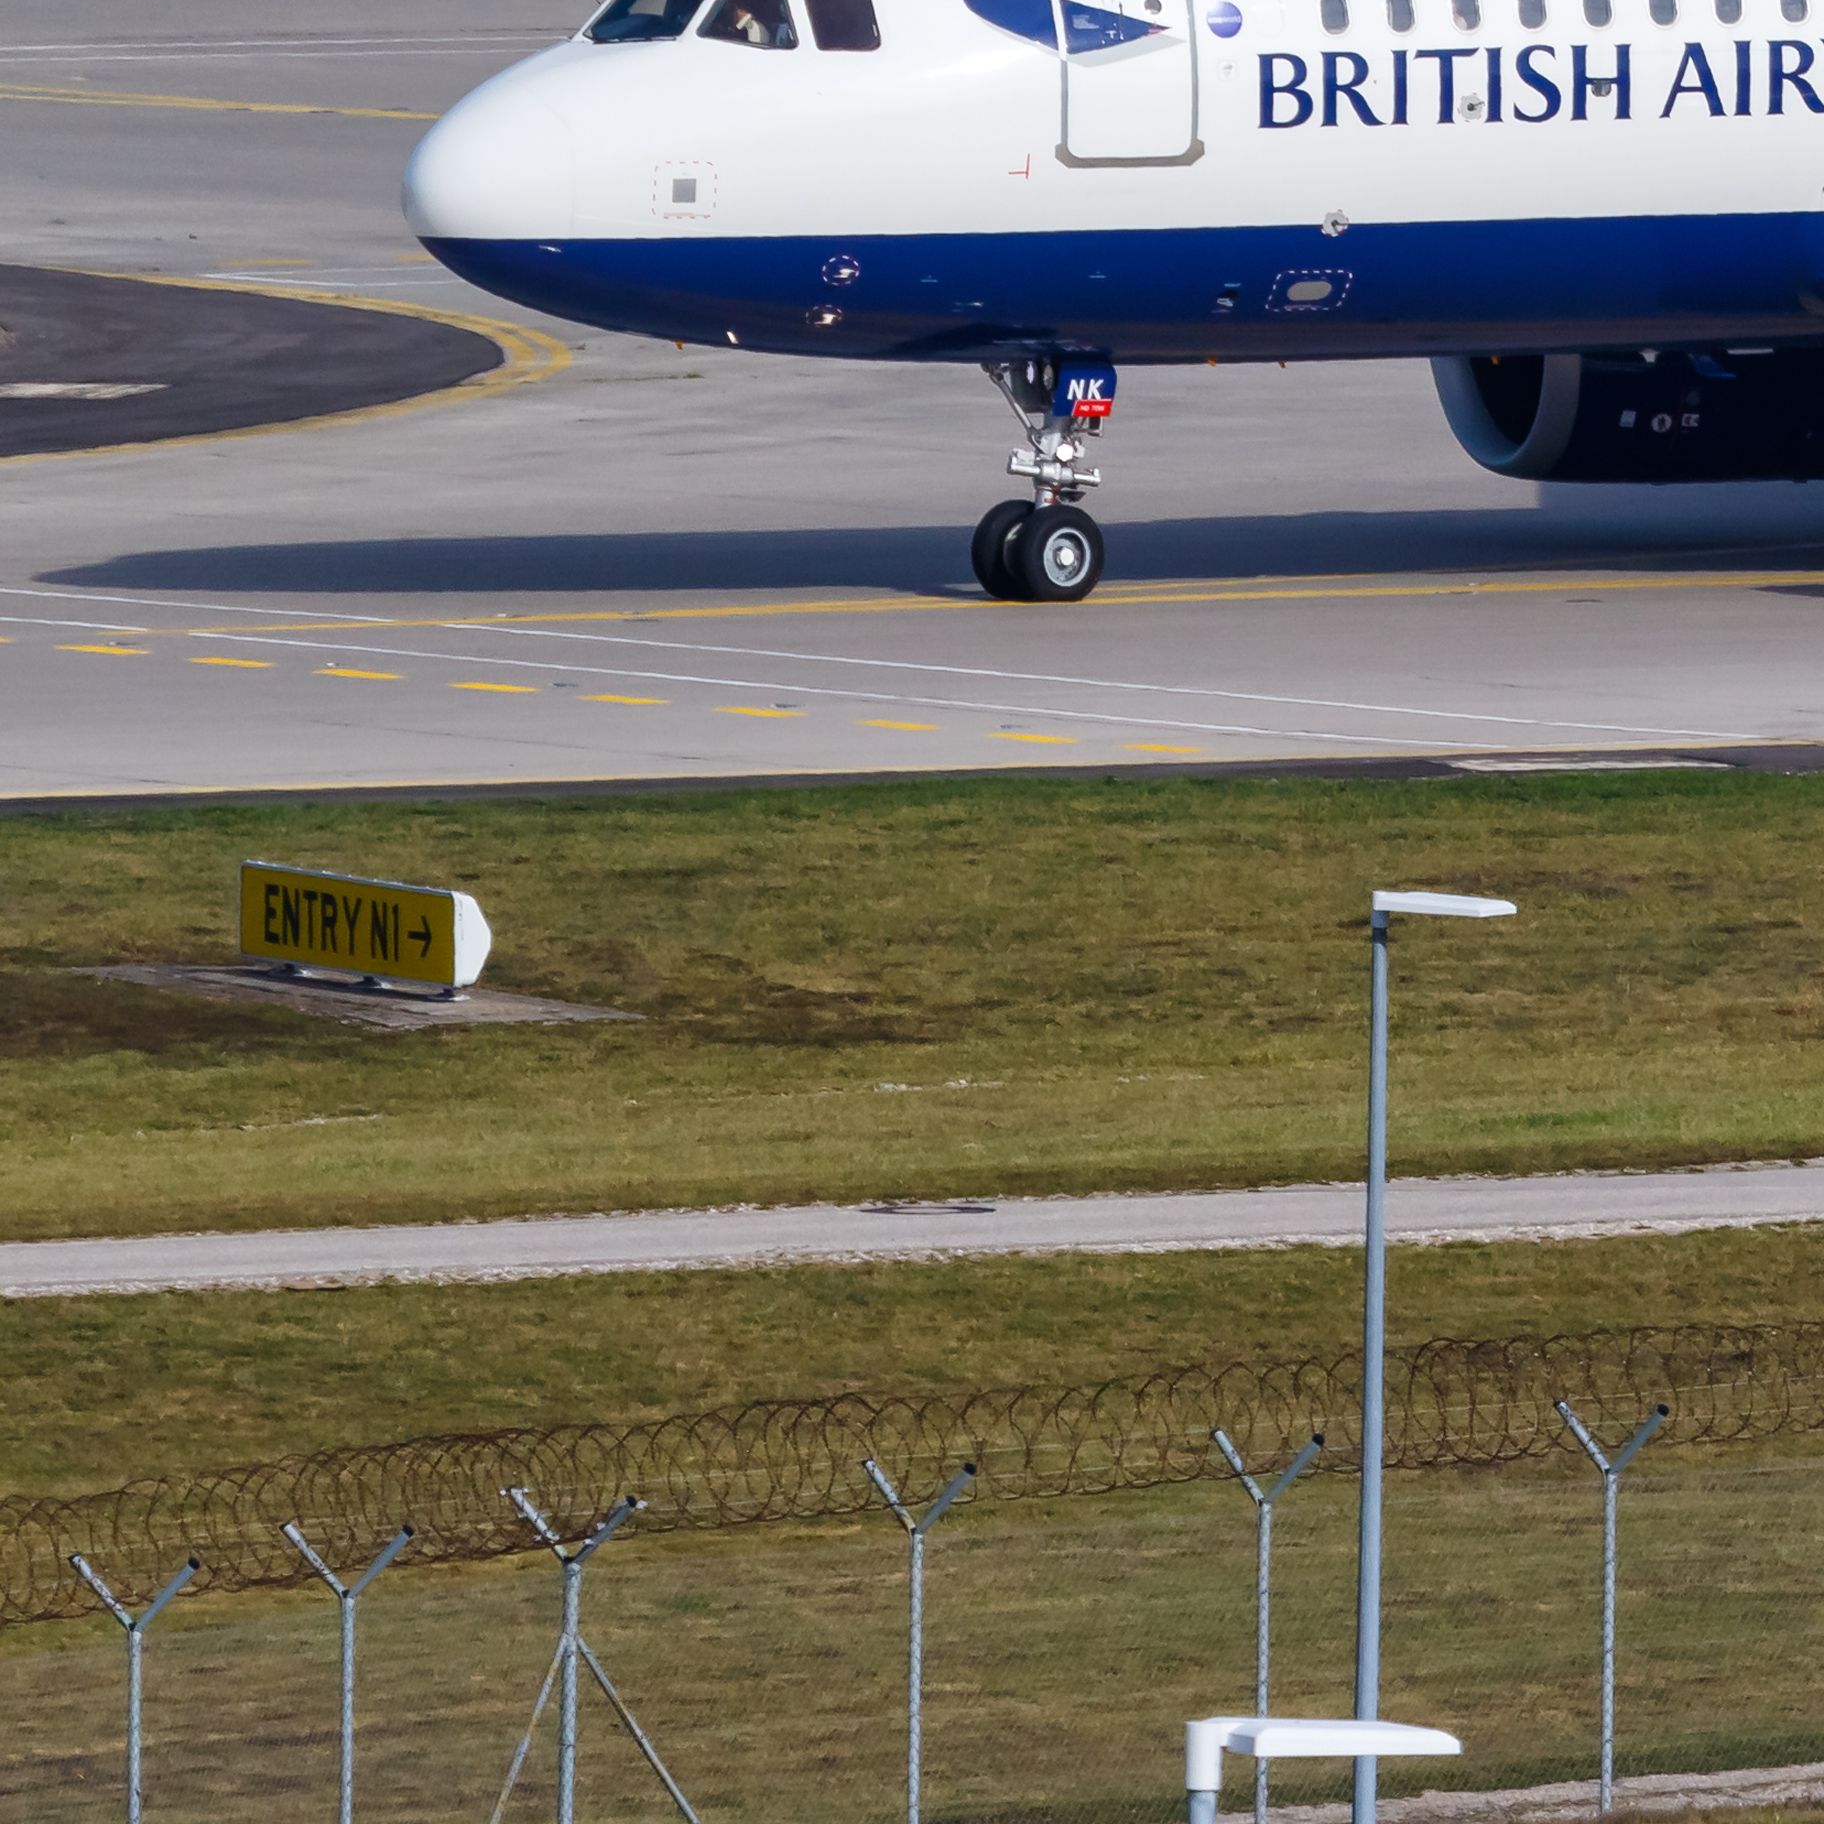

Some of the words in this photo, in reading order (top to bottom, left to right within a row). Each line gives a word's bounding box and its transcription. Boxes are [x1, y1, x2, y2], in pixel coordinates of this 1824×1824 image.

[1257, 43, 1632, 129] BRITISH
[1067, 378, 1105, 401] NK
[263, 883, 362, 956] ENTRY
